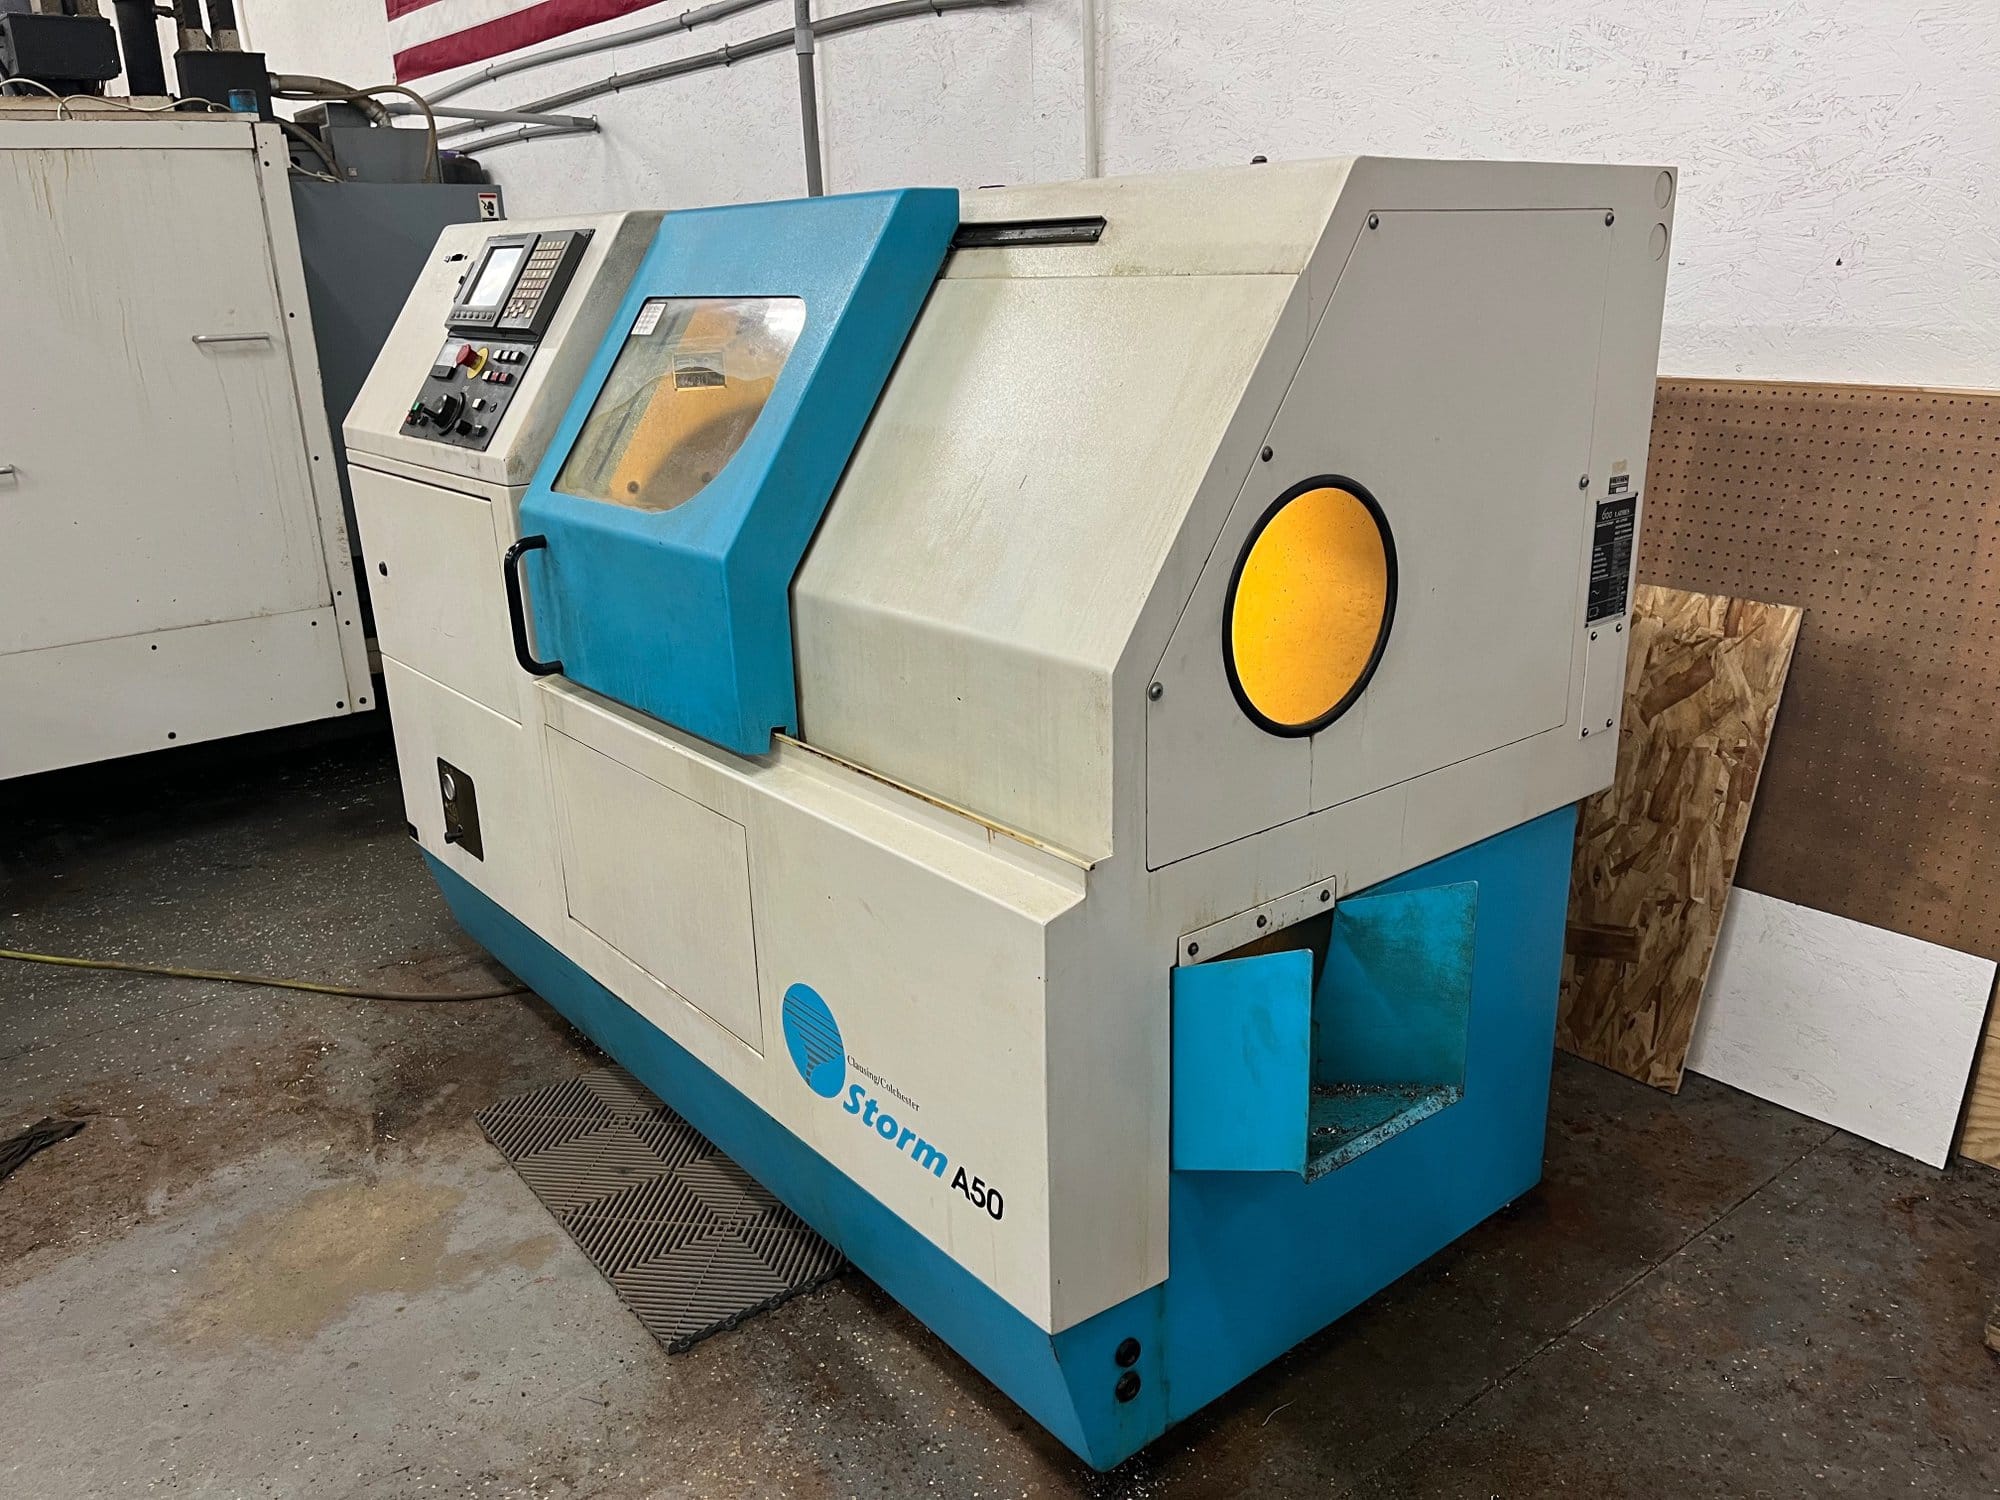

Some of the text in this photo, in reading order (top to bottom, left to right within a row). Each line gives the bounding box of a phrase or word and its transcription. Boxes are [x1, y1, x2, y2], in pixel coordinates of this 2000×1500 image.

[847, 1054, 920, 1111] Clausing/Colchester
[843, 1083, 1004, 1221] Storm A50
